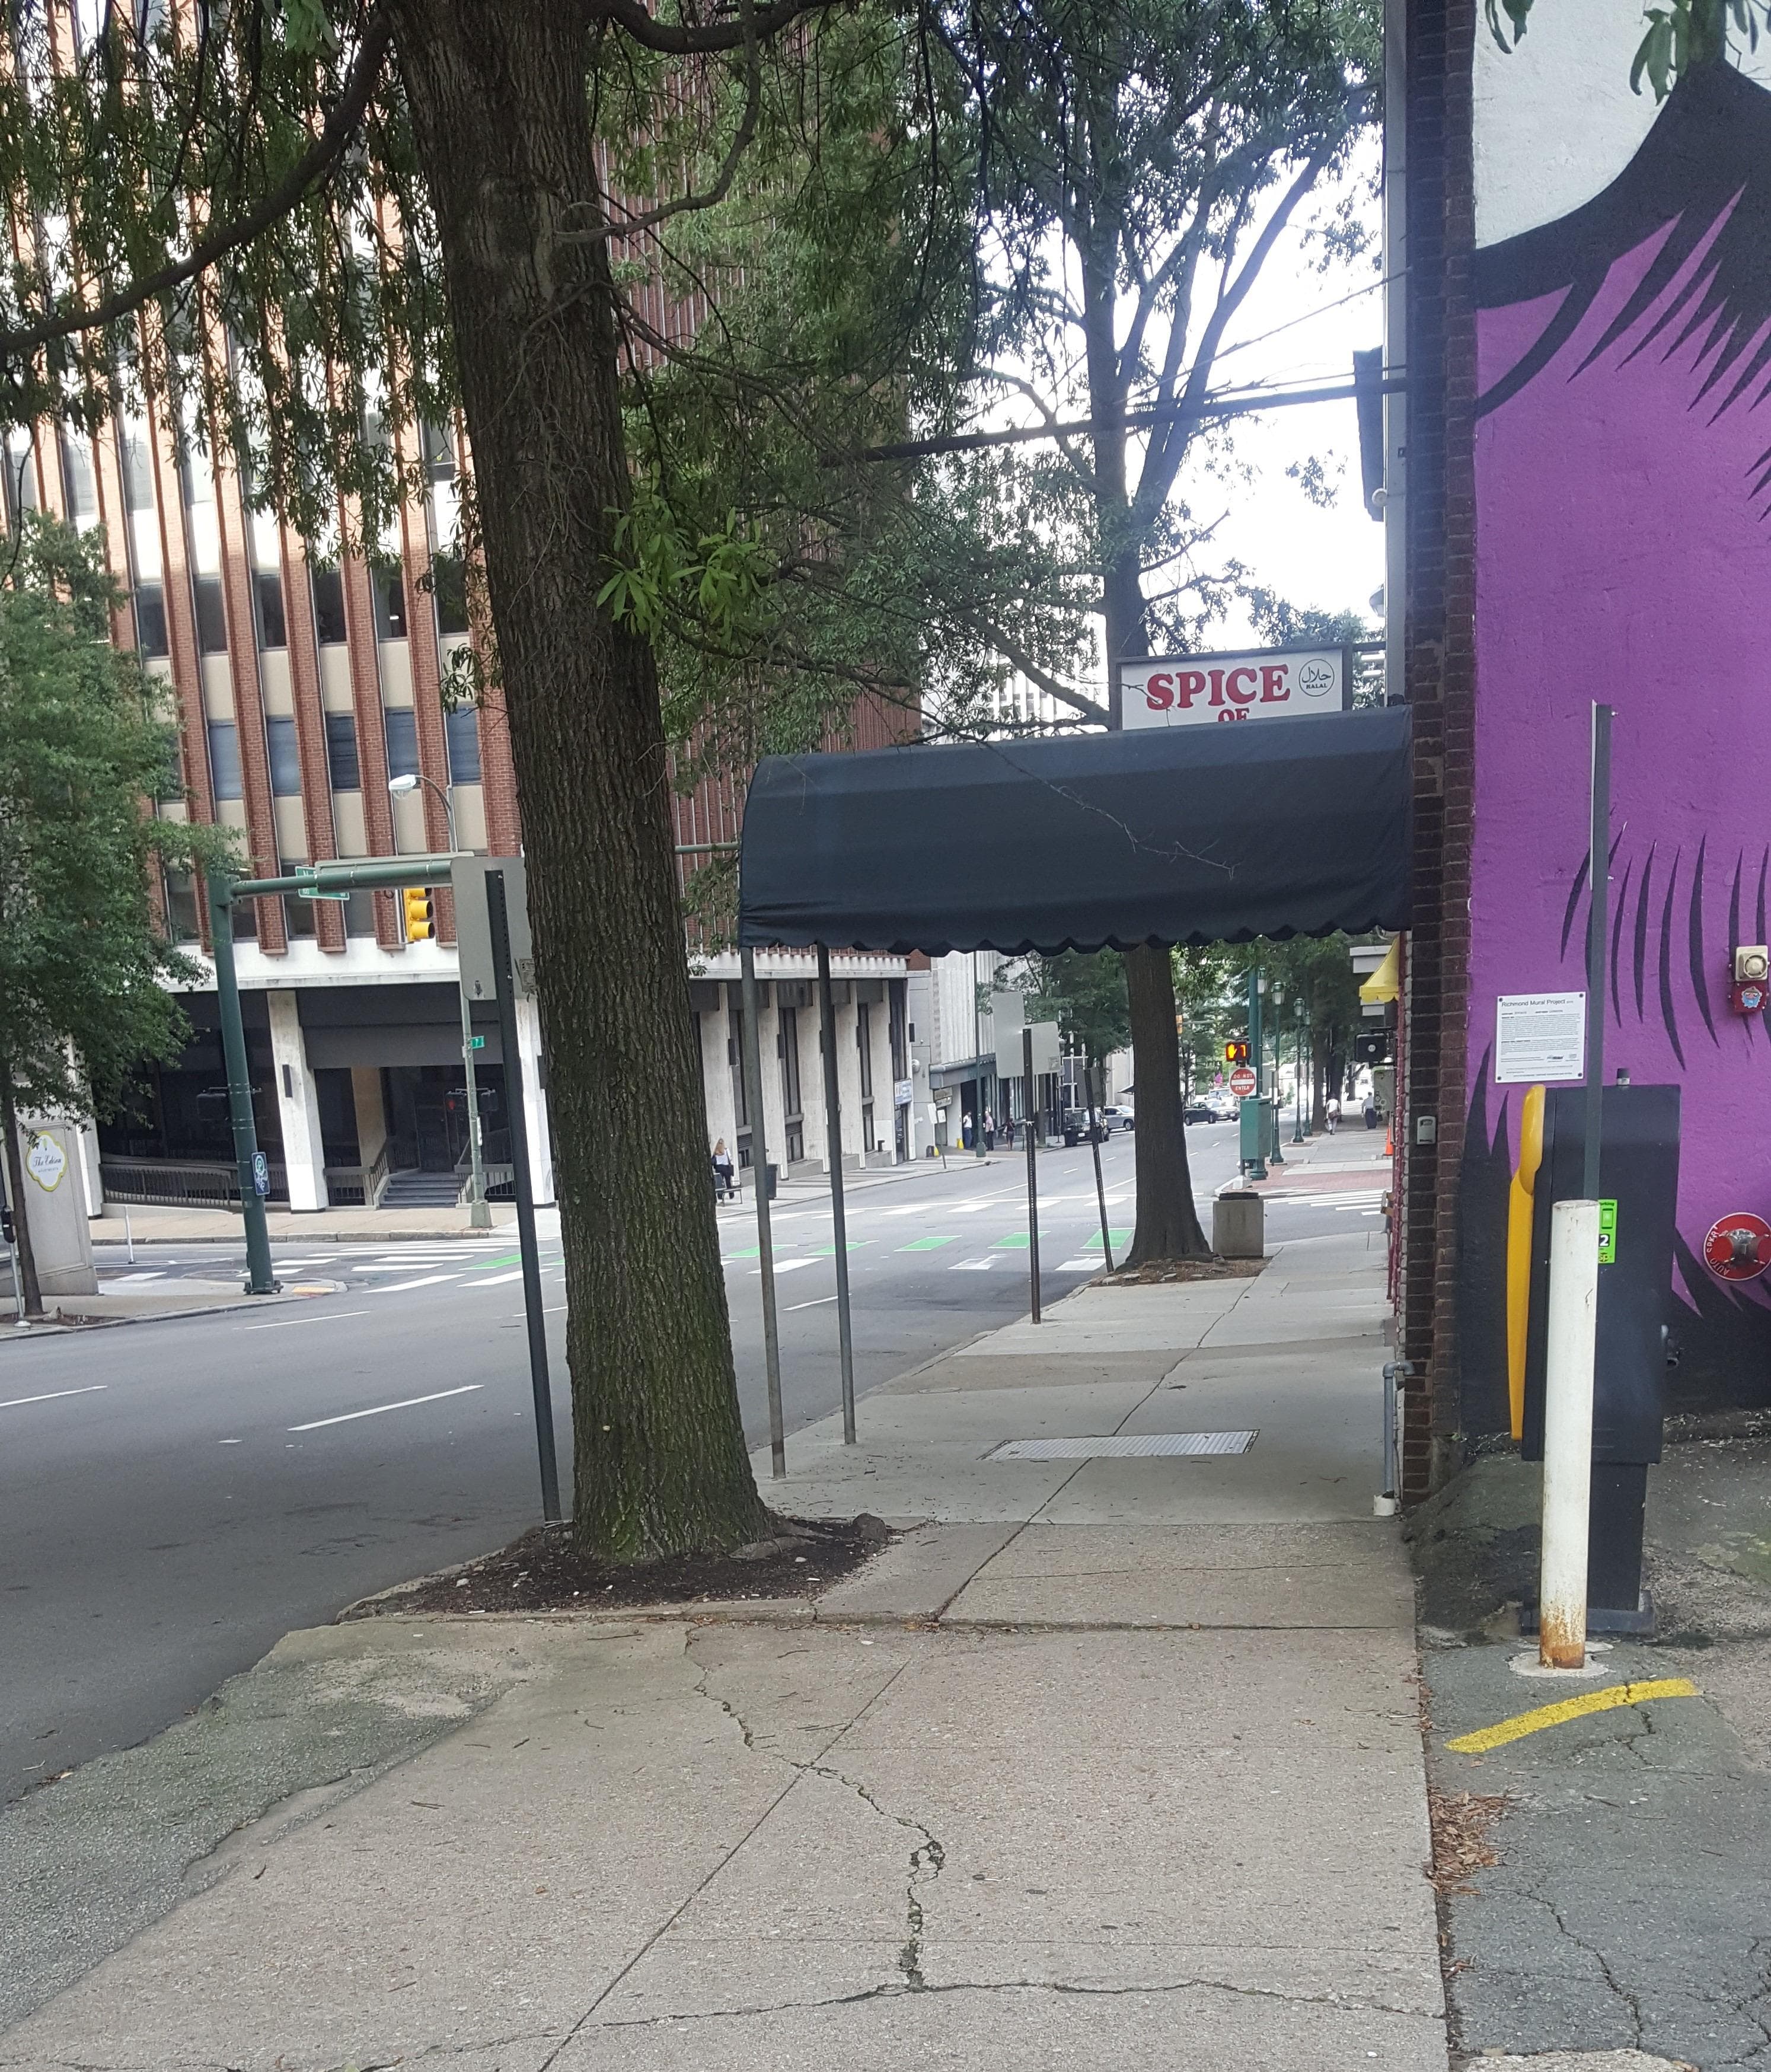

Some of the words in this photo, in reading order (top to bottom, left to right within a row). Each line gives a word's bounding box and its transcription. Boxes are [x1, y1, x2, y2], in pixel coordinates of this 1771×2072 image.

[1301, 666, 1332, 683] حلال
[1147, 664, 1290, 710] SPICE
[1709, 1258, 1730, 1276] AUTO
